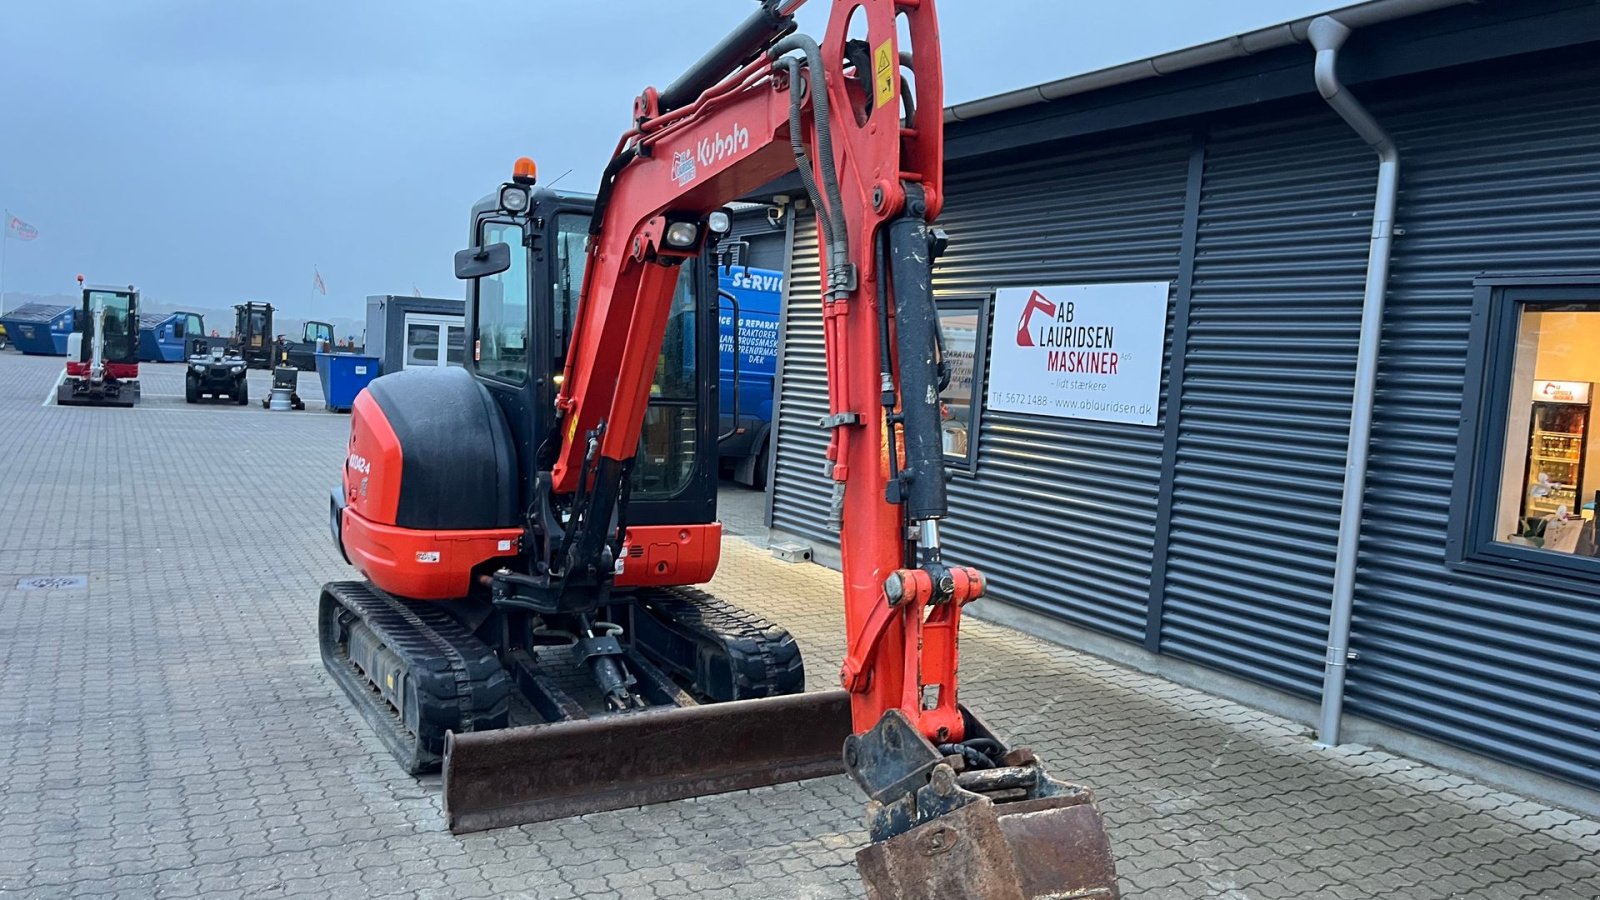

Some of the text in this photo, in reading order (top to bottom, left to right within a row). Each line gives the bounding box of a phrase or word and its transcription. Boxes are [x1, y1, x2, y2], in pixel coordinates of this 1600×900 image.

[697, 122, 749, 167] Kubota
[1057, 302, 1075, 323] AB
[1039, 326, 1114, 348] LAURIDSEN
[748, 354, 765, 365] DÆK
[1047, 350, 1119, 375] MASKINER
[1056, 377, 1069, 390] lidt
[1070, 379, 1107, 392] stærkere
[1006, 392, 1026, 405] 5672
[1027, 393, 1048, 406] 1488
[1055, 399, 1152, 416] www.ablauridsen.dk
